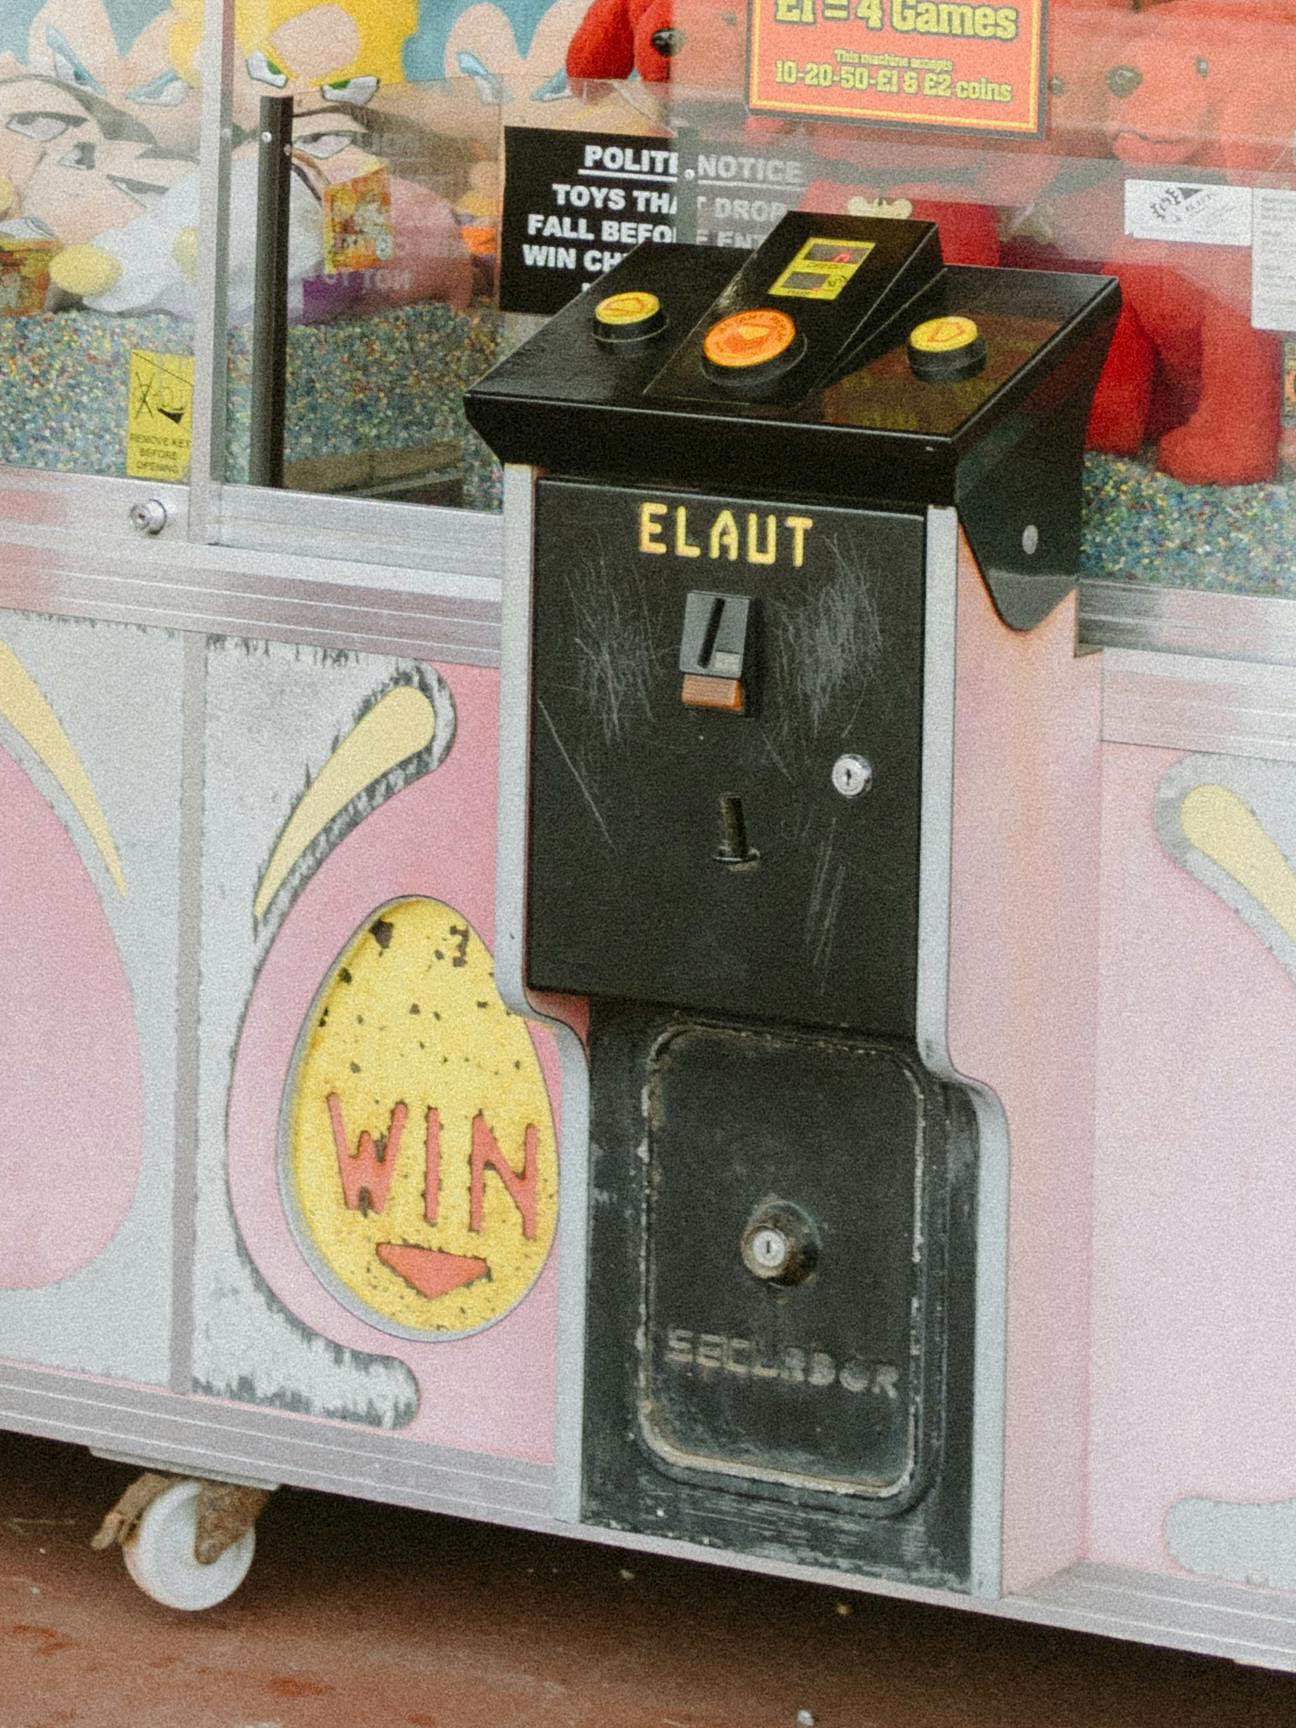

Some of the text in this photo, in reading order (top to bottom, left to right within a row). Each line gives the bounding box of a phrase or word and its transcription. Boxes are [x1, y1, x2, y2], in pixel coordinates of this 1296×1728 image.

[834, 48, 859, 63] This
[775, 59, 899, 93] 10-20-50-£1
[923, 72, 951, 98] £2
[955, 75, 1013, 103] coins
[697, 154, 802, 184] NOTICE
[552, 183, 626, 211] TOYS
[715, 198, 789, 222] DROP
[527, 214, 594, 241] FALL
[522, 244, 577, 270] WIN
[639, 501, 813, 568] ELAUT
[326, 1091, 540, 1242] WIN
